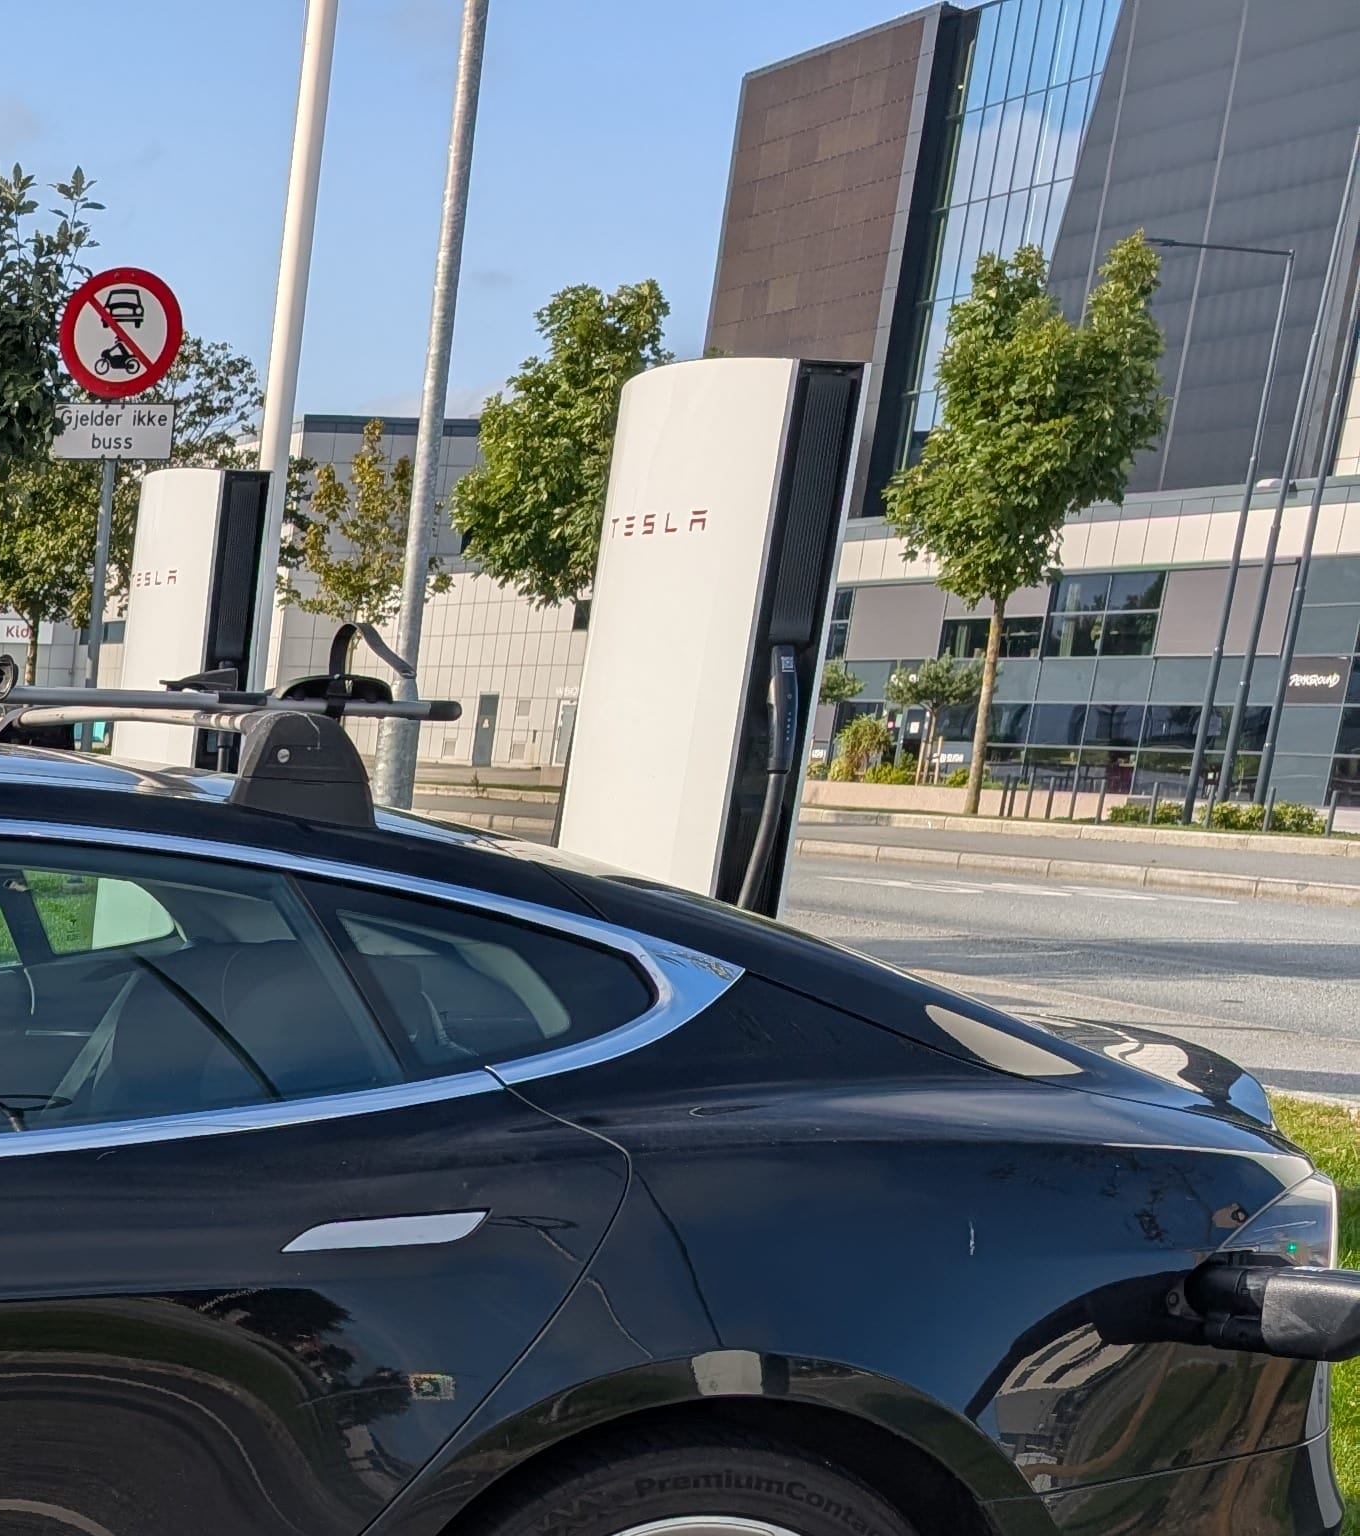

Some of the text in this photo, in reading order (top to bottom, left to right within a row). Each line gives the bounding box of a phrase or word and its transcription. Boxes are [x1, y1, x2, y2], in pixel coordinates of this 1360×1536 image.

[61, 409, 168, 431] Gjelder ikke
[91, 433, 133, 450] buss
[611, 509, 709, 539] TESLA
